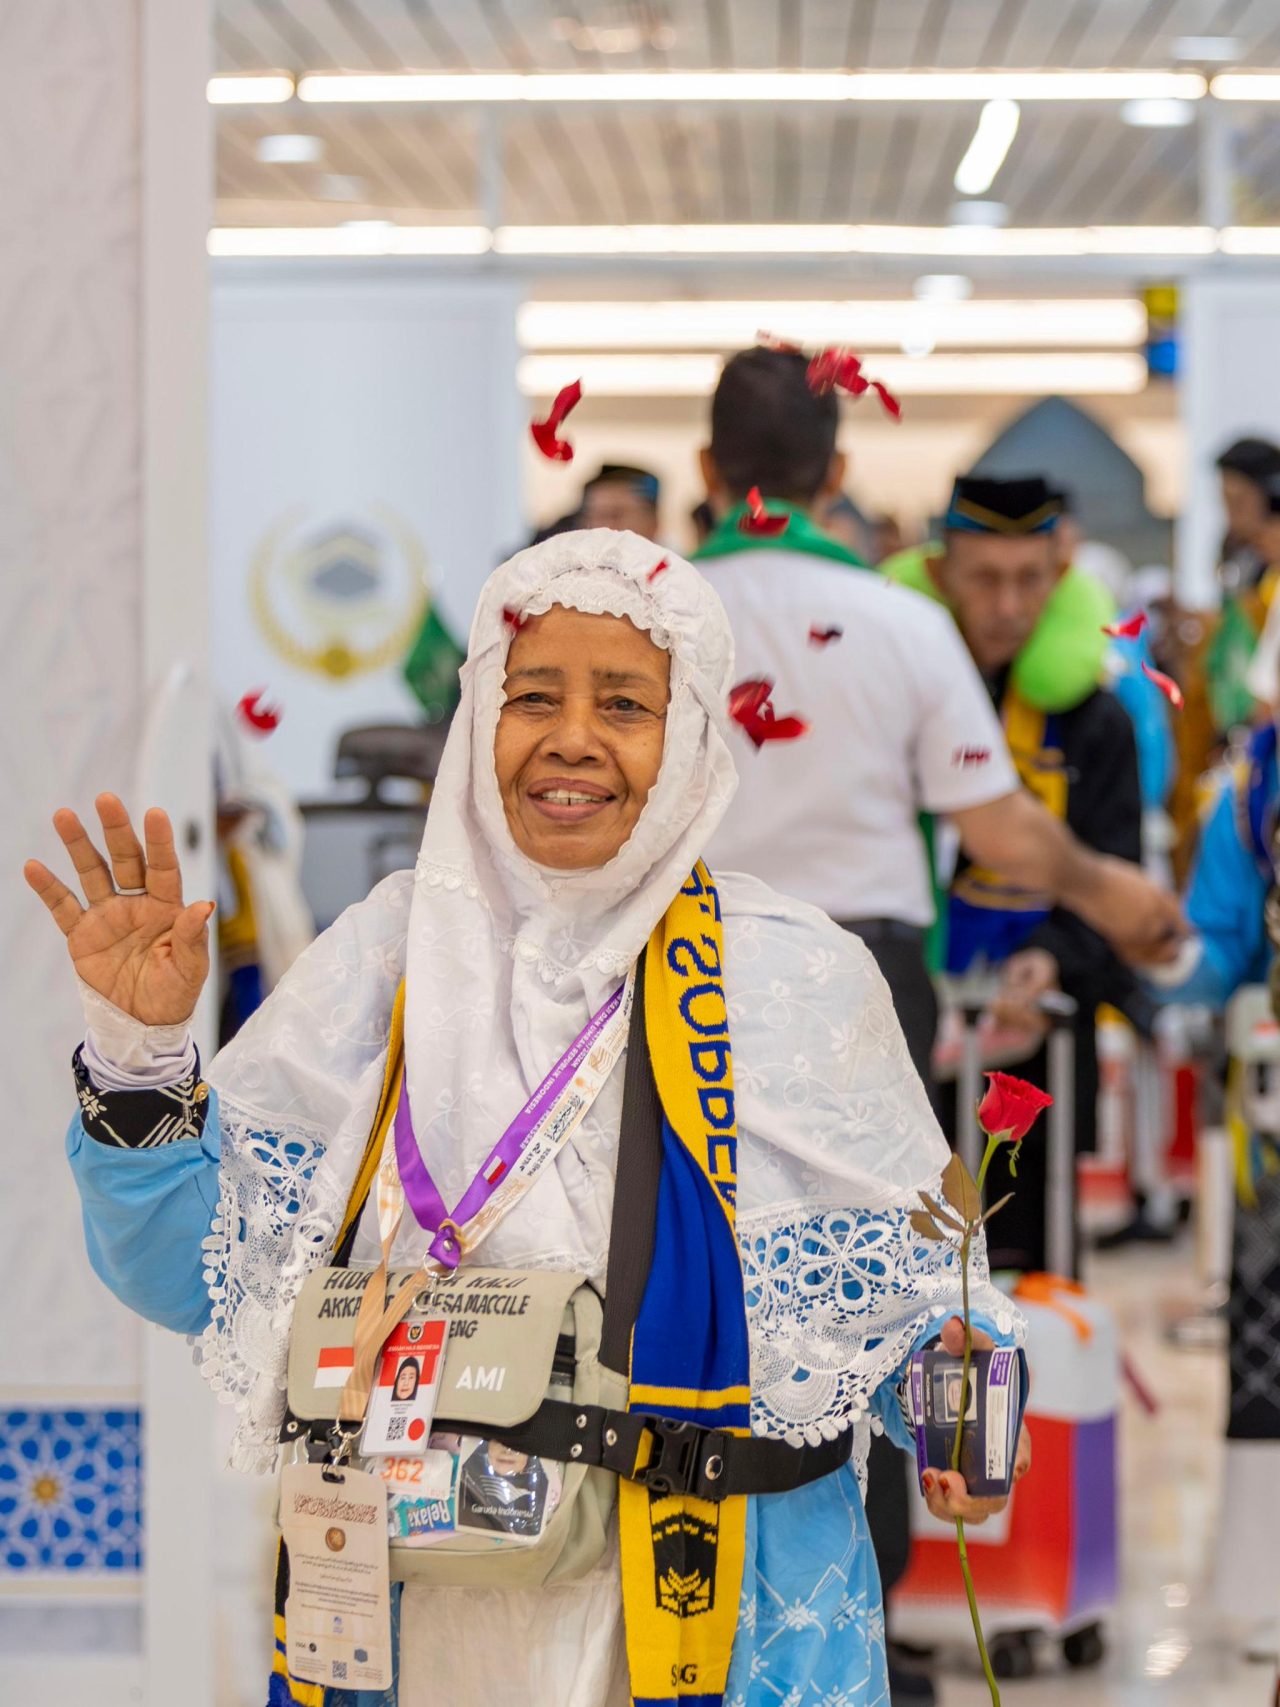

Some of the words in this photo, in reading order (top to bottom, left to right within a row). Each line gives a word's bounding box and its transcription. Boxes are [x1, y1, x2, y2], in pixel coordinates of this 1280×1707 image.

[523, 1076, 556, 1115] INDONESIA
[455, 1366, 506, 1391] AMI
[471, 1503, 498, 1515] Garuda
